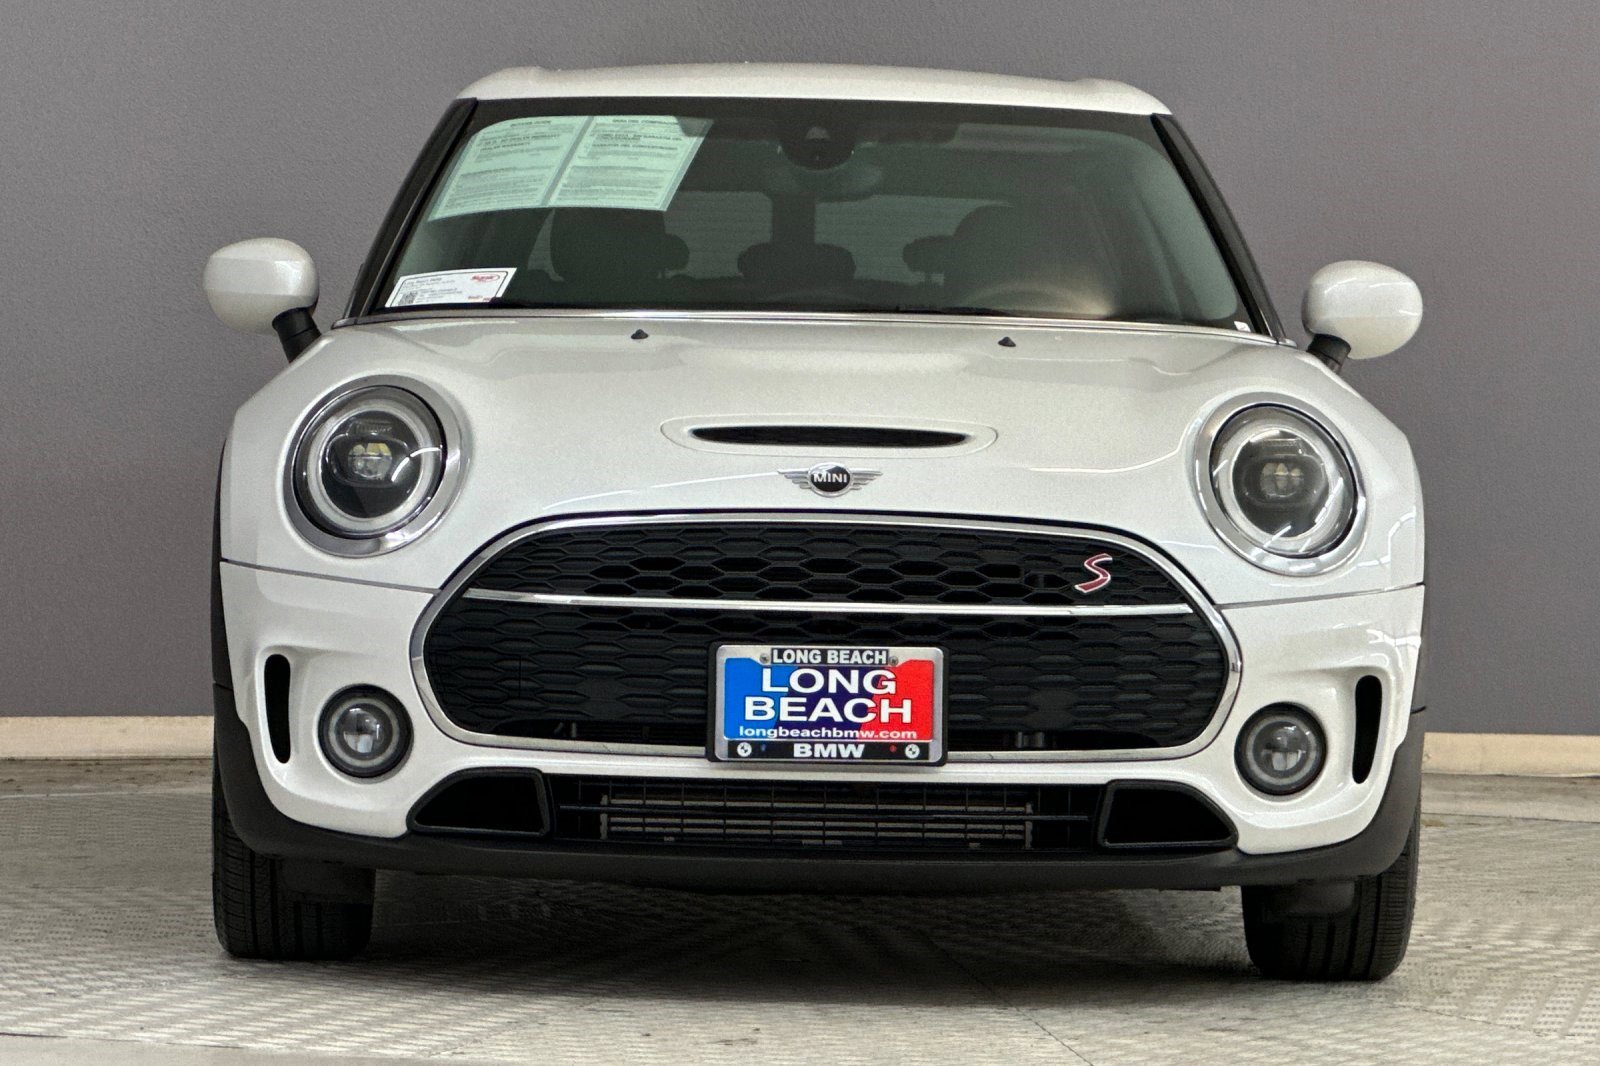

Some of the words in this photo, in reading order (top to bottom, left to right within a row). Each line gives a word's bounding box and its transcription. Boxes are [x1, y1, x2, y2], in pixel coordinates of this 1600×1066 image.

[813, 472, 848, 483] MINI
[1074, 553, 1113, 593] S
[772, 649, 822, 664] LONG
[827, 650, 887, 665] BEACH
[761, 668, 897, 695] LONG
[744, 696, 912, 723] BEACH
[739, 726, 918, 739] longbeachbmw.com
[793, 743, 865, 758] BMW
